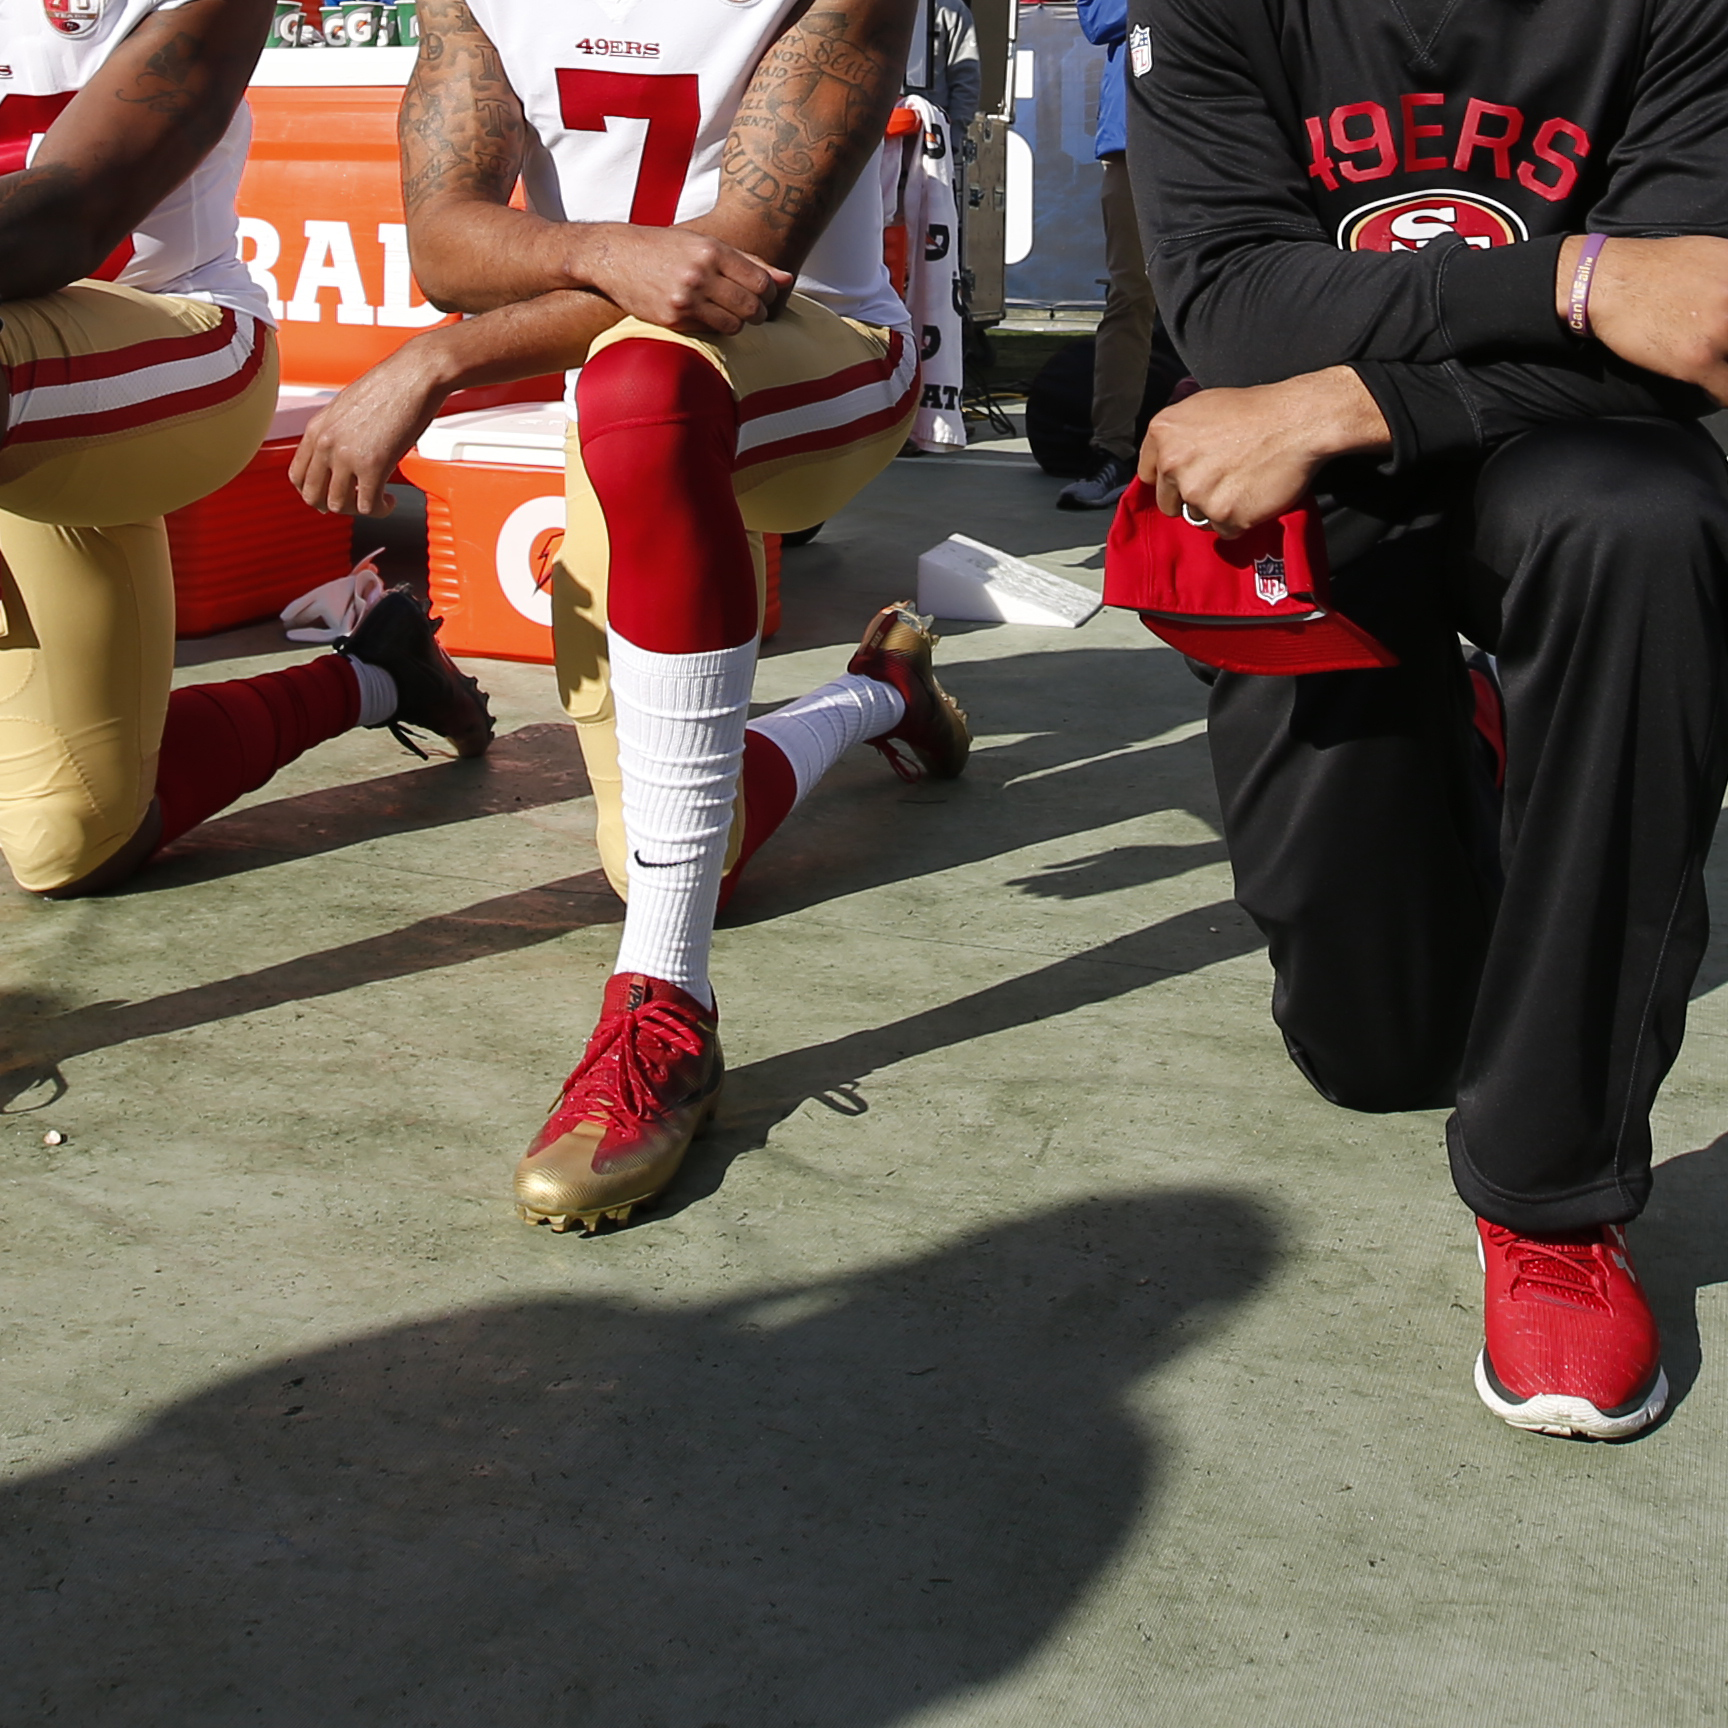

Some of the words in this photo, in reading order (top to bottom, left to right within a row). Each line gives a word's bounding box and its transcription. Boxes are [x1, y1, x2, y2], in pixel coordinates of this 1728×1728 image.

[346, 11, 373, 43] G
[574, 37, 661, 59] 49ERS
[554, 67, 700, 226] 7
